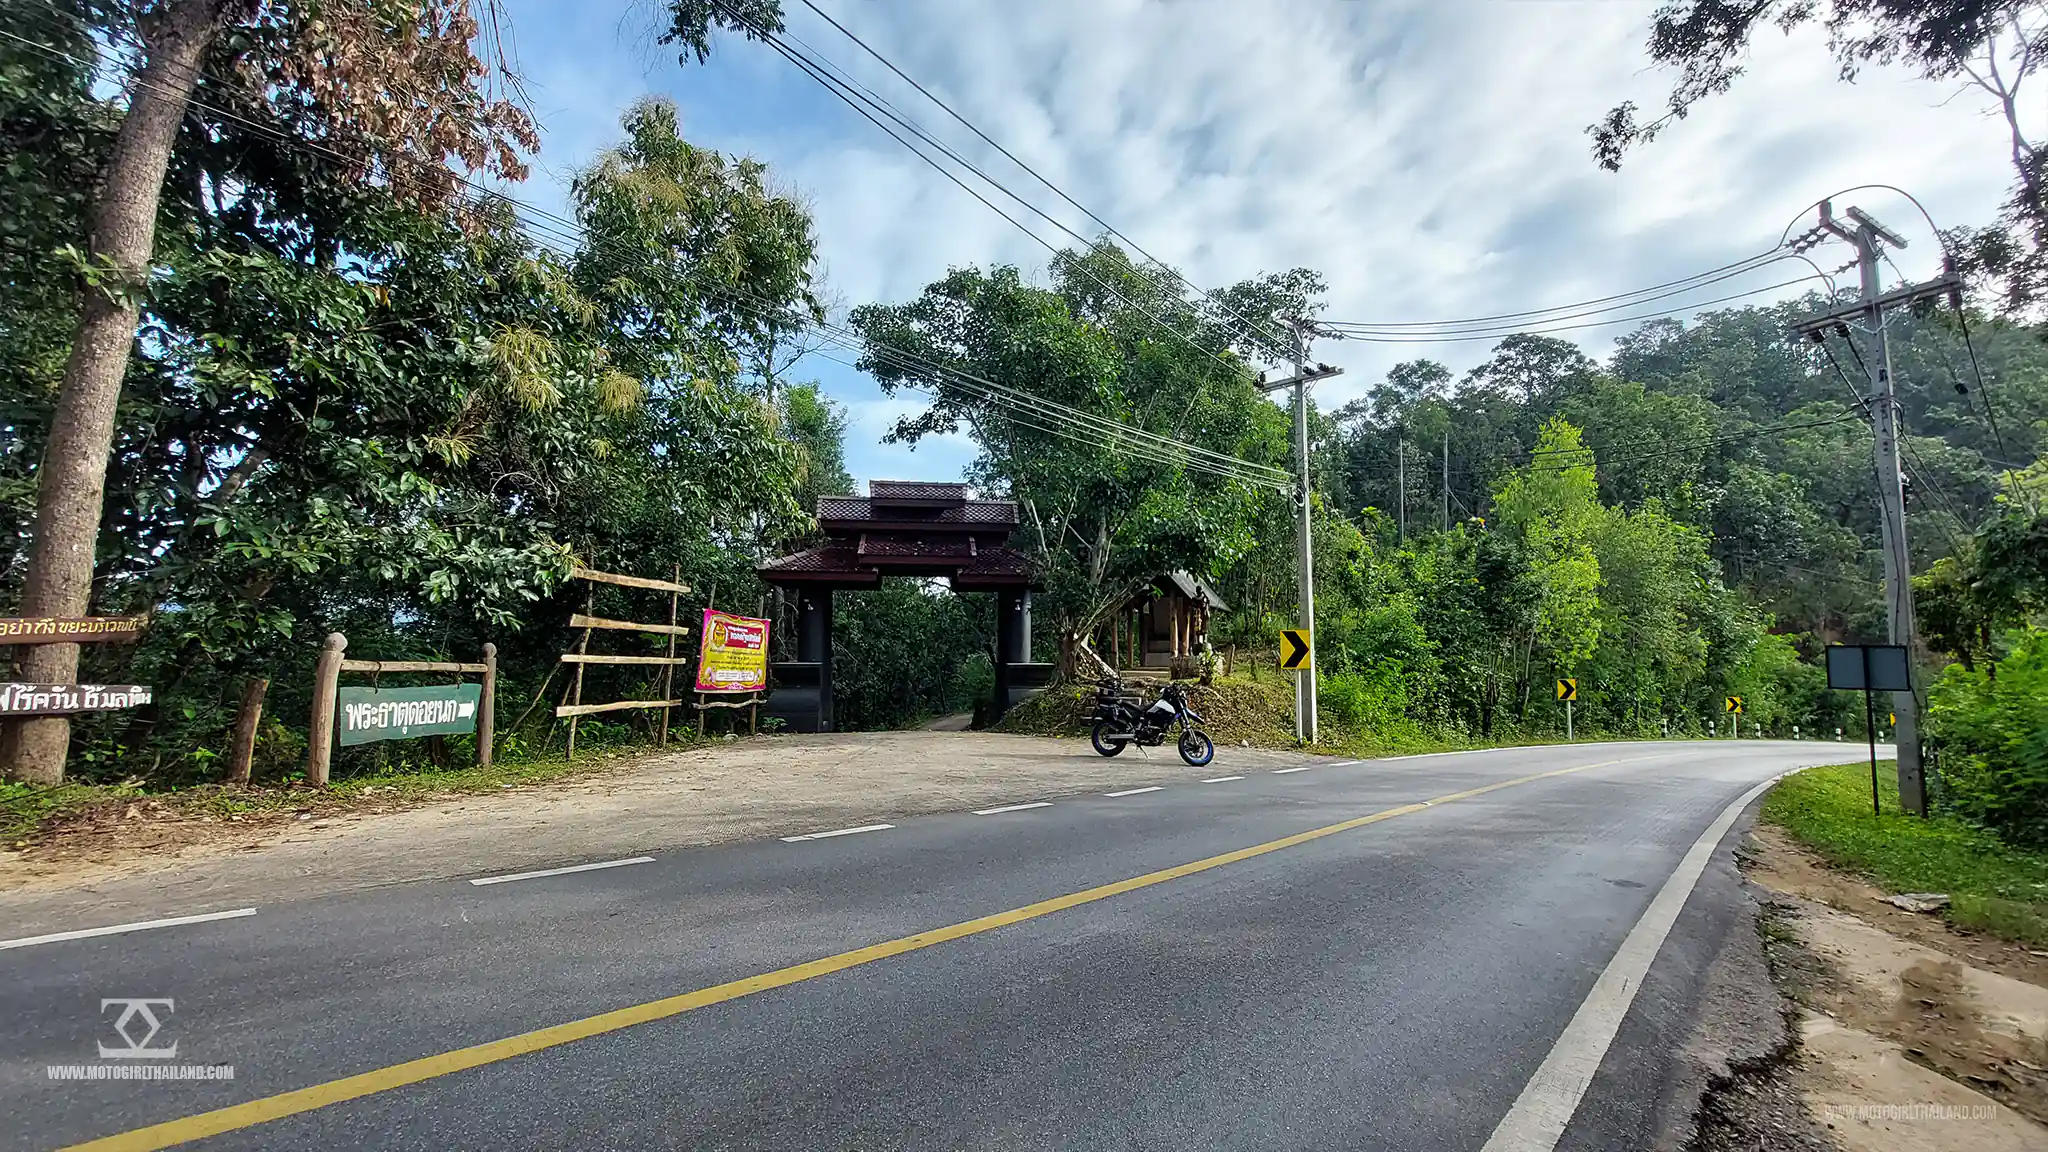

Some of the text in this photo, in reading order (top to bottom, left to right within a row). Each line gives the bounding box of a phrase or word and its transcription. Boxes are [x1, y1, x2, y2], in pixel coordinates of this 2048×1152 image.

[346, 700, 457, 735] พระธาตุดอยนก
